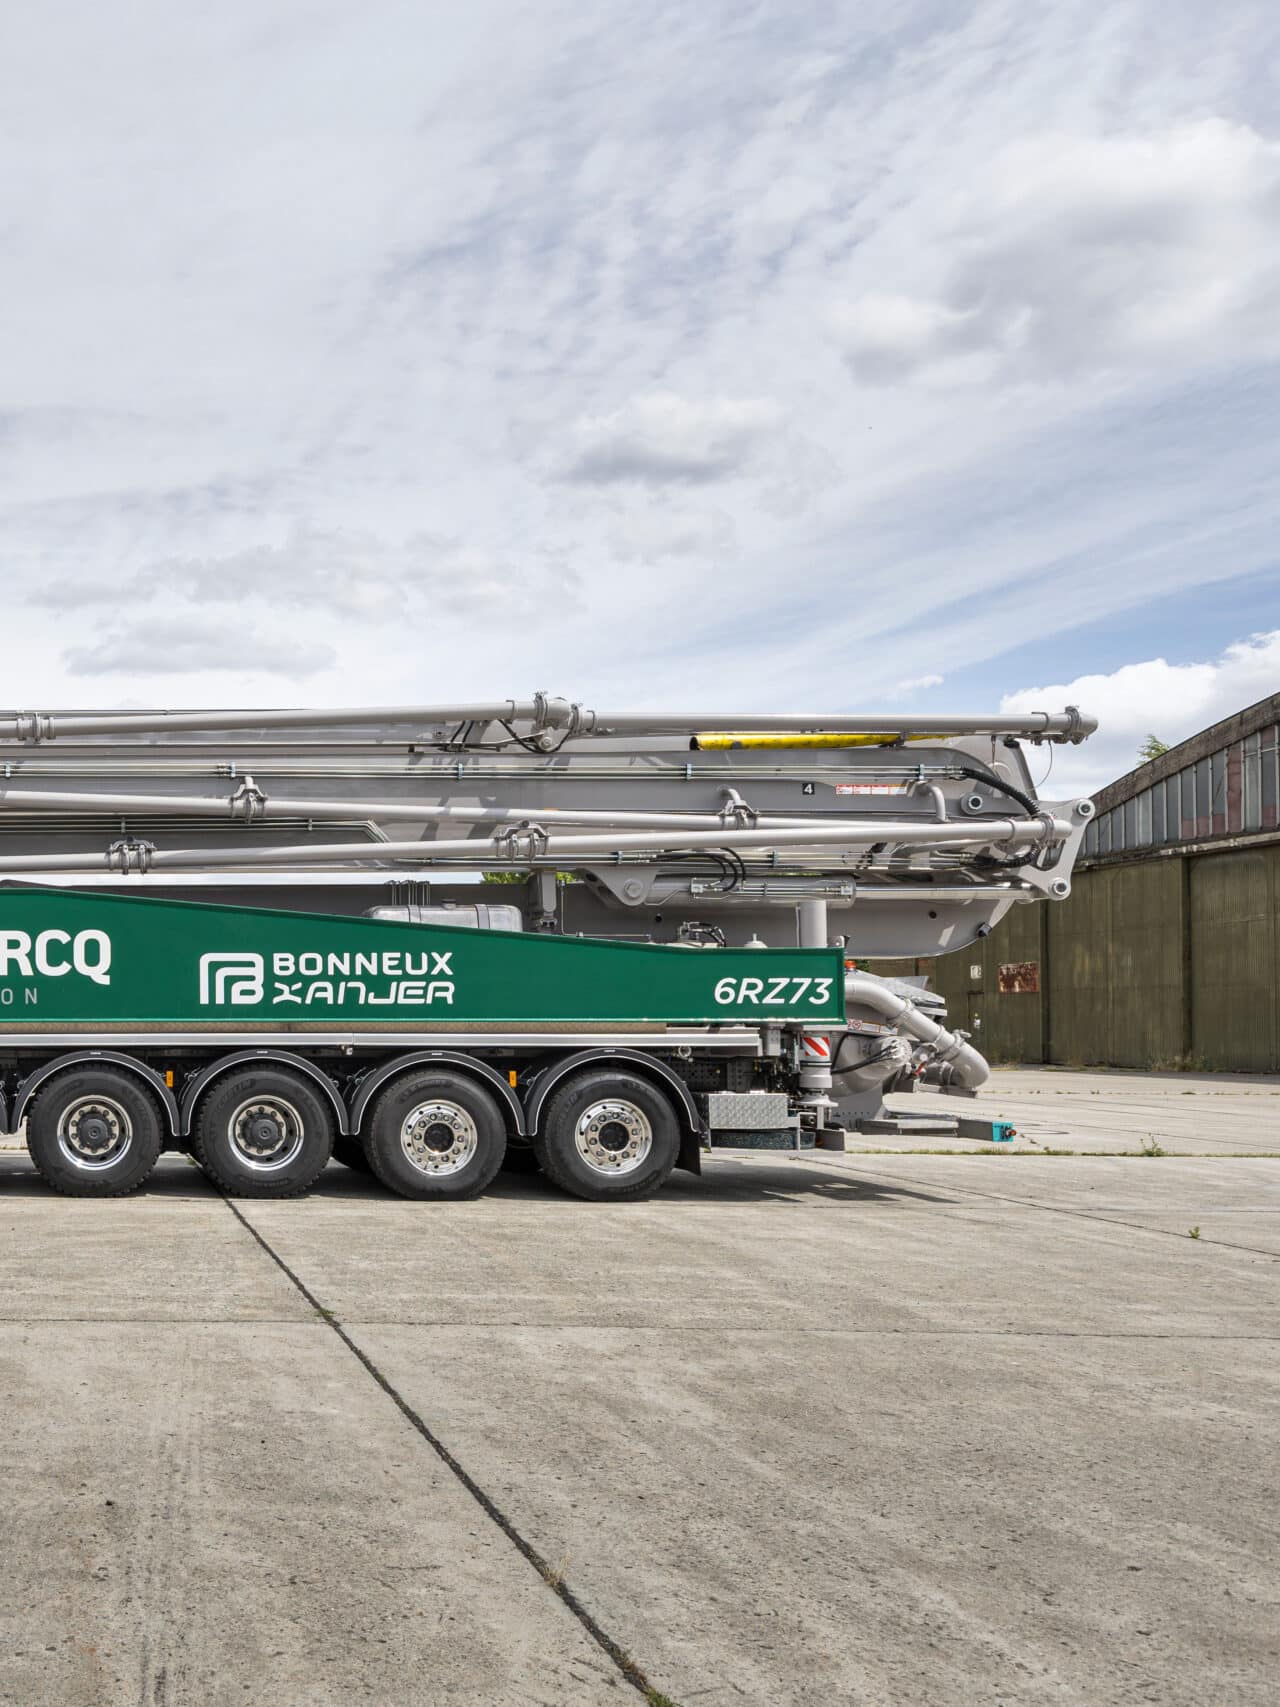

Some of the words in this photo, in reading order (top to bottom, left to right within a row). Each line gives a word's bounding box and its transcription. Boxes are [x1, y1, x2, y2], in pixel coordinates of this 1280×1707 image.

[804, 783, 813, 794] 4
[272, 951, 454, 976] BONNEUX
[272, 981, 455, 1005] XANJER
[713, 976, 834, 1006] 6RZ73
